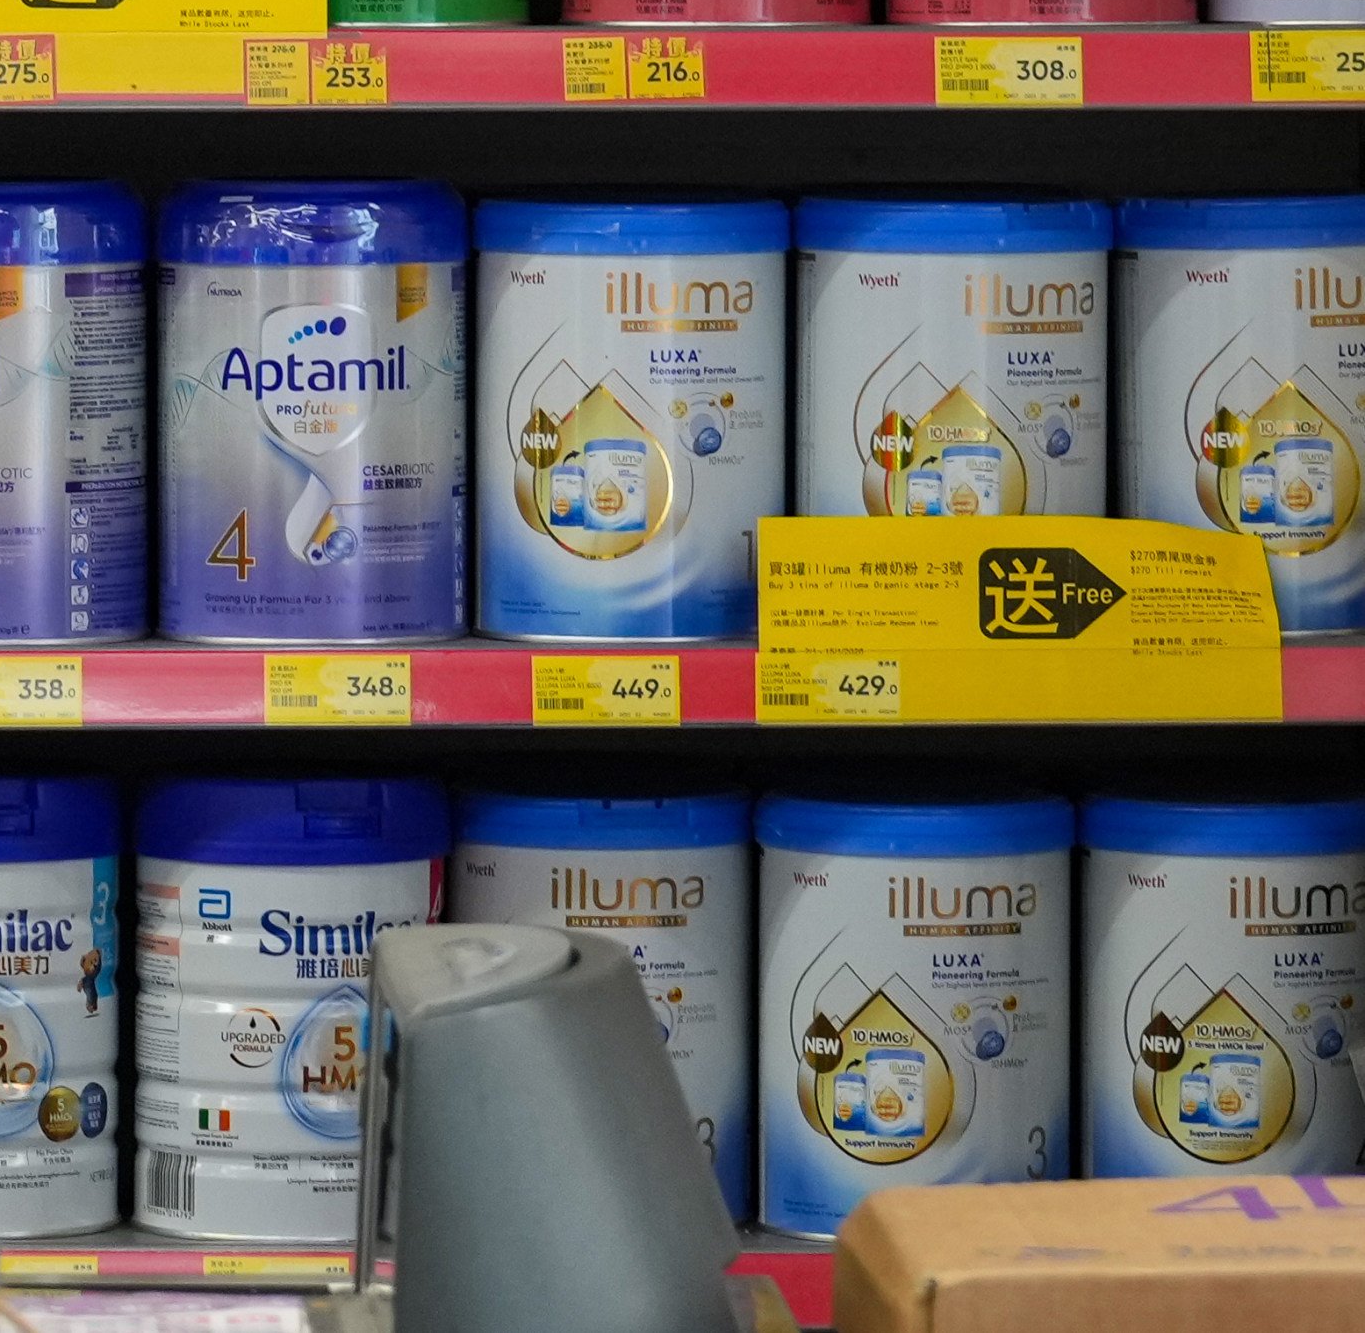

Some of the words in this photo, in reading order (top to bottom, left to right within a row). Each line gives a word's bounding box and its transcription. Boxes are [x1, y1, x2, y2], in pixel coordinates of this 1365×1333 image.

[326, 68, 383, 87] 253.0
[1016, 60, 1076, 80] 308.0
[605, 271, 755, 315] illuma
[964, 273, 1094, 317] illuma
[222, 345, 410, 402] Aptamil
[522, 433, 559, 452] NEW
[873, 435, 914, 453] NEW
[207, 506, 256, 582] 4
[985, 557, 1057, 634] 送
[1061, 584, 1113, 606] Free
[17, 679, 76, 699] 358.0
[347, 676, 406, 697] 348.0
[611, 678, 671, 699] 449.0
[551, 868, 705, 911] illuma
[1274, 953, 1320, 967] LUXA
[220, 1031, 286, 1045] UPGRADED
[334, 1025, 355, 1061] 5
[804, 1036, 839, 1056] NEW
[852, 1030, 867, 1043] 10
[870, 1030, 910, 1046] HMOs
[1141, 1035, 1181, 1055] NEW
[1027, 1126, 1047, 1179] 3
